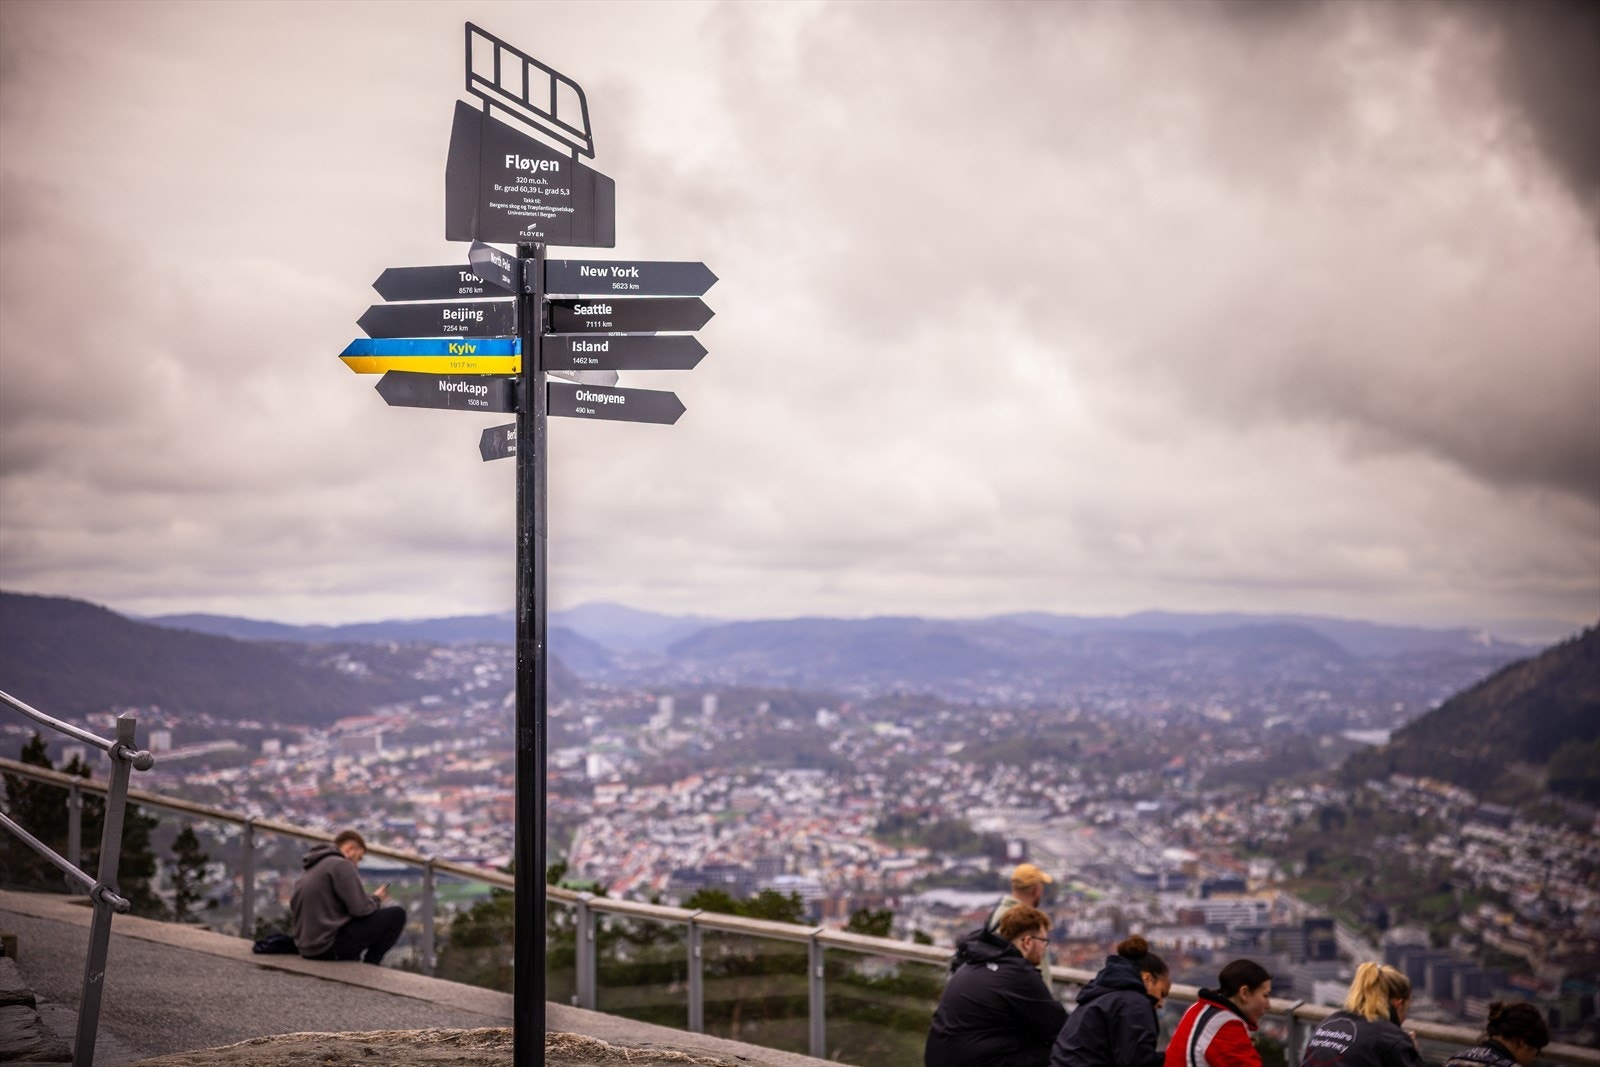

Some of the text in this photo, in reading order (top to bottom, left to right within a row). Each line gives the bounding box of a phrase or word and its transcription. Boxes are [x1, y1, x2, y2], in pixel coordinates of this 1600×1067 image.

[505, 154, 560, 173] Fløyen
[504, 185, 519, 193] grad
[519, 186, 537, 194] 60,39
[544, 188, 559, 196] grad
[560, 188, 570, 196] 5,3
[580, 266, 639, 278] New York
[612, 282, 639, 290] 5623 km
[443, 308, 484, 322] Beijing
[573, 304, 612, 315] Seattle
[448, 342, 477, 356] Kyiv
[572, 341, 609, 352] Island
[439, 380, 488, 396] Nordkapp
[575, 390, 625, 405] Orknøyene
[575, 406, 586, 414] 490
